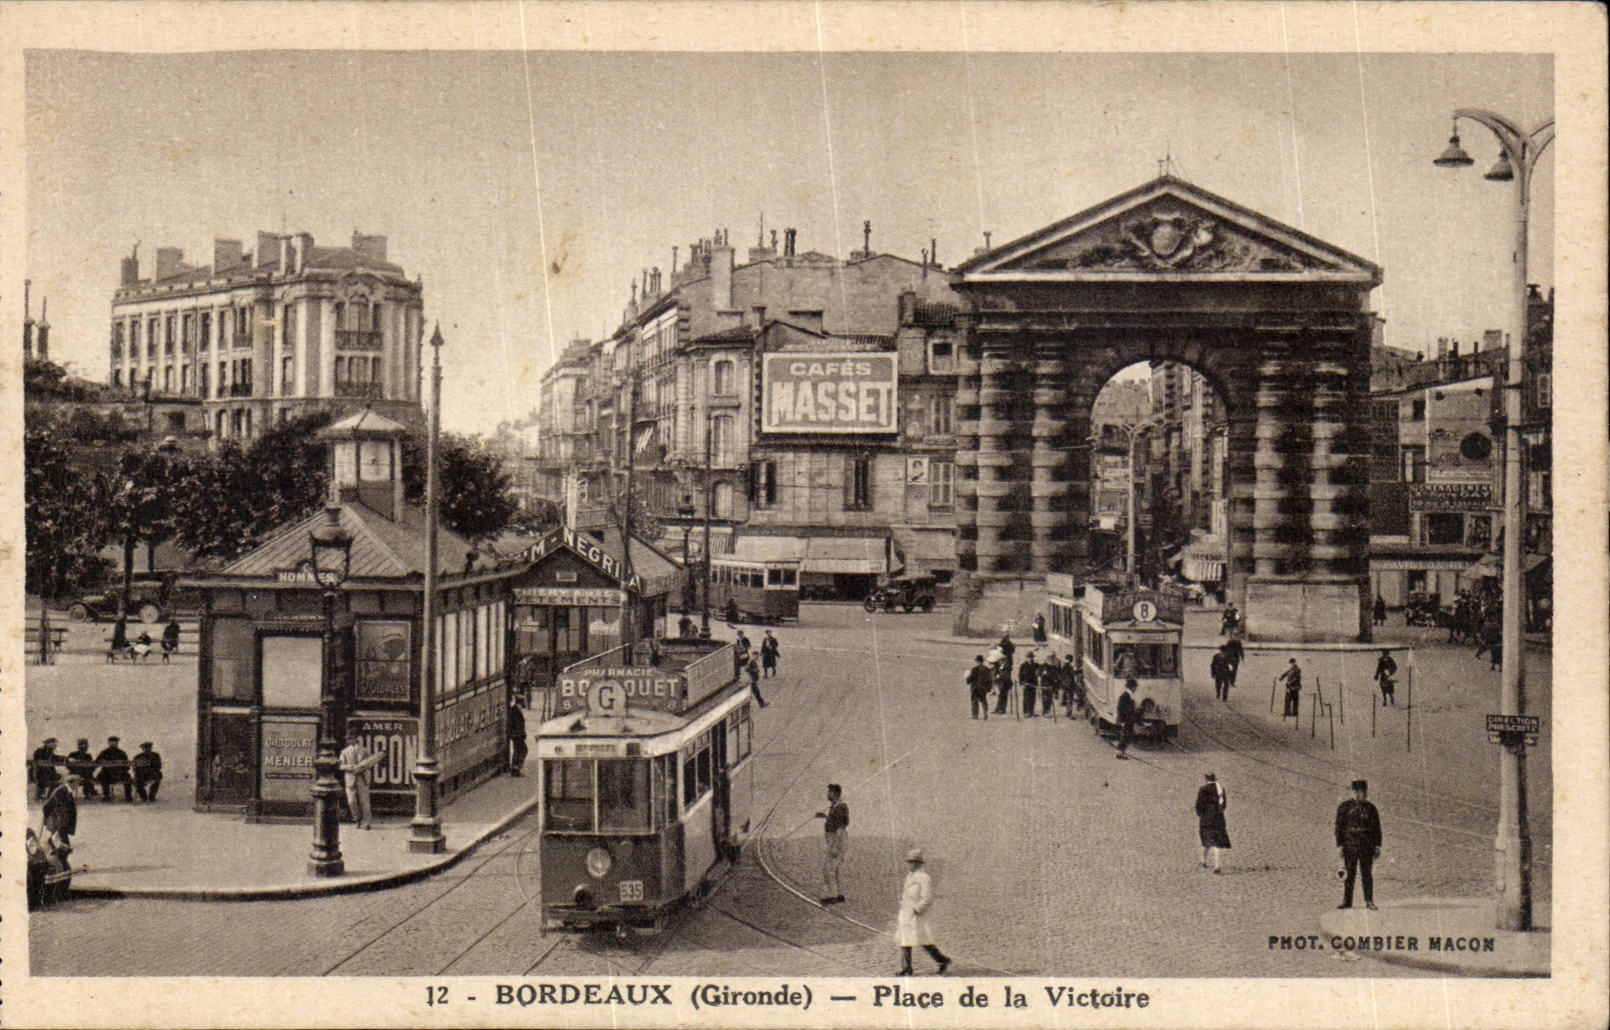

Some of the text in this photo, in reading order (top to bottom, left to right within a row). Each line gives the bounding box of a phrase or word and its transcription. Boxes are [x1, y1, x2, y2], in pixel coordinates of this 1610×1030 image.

[790, 360, 872, 376] CAFÉS
[771, 381, 893, 426] MASSET
[563, 526, 641, 593] NEGRIA
[279, 571, 336, 583] HOMMES
[1140, 603, 1149, 619] 8
[584, 668, 653, 677] PHARMACIE
[599, 686, 614, 710] G
[362, 722, 402, 730] AMER
[264, 755, 314, 768] MENIER
[357, 734, 418, 785] ICON
